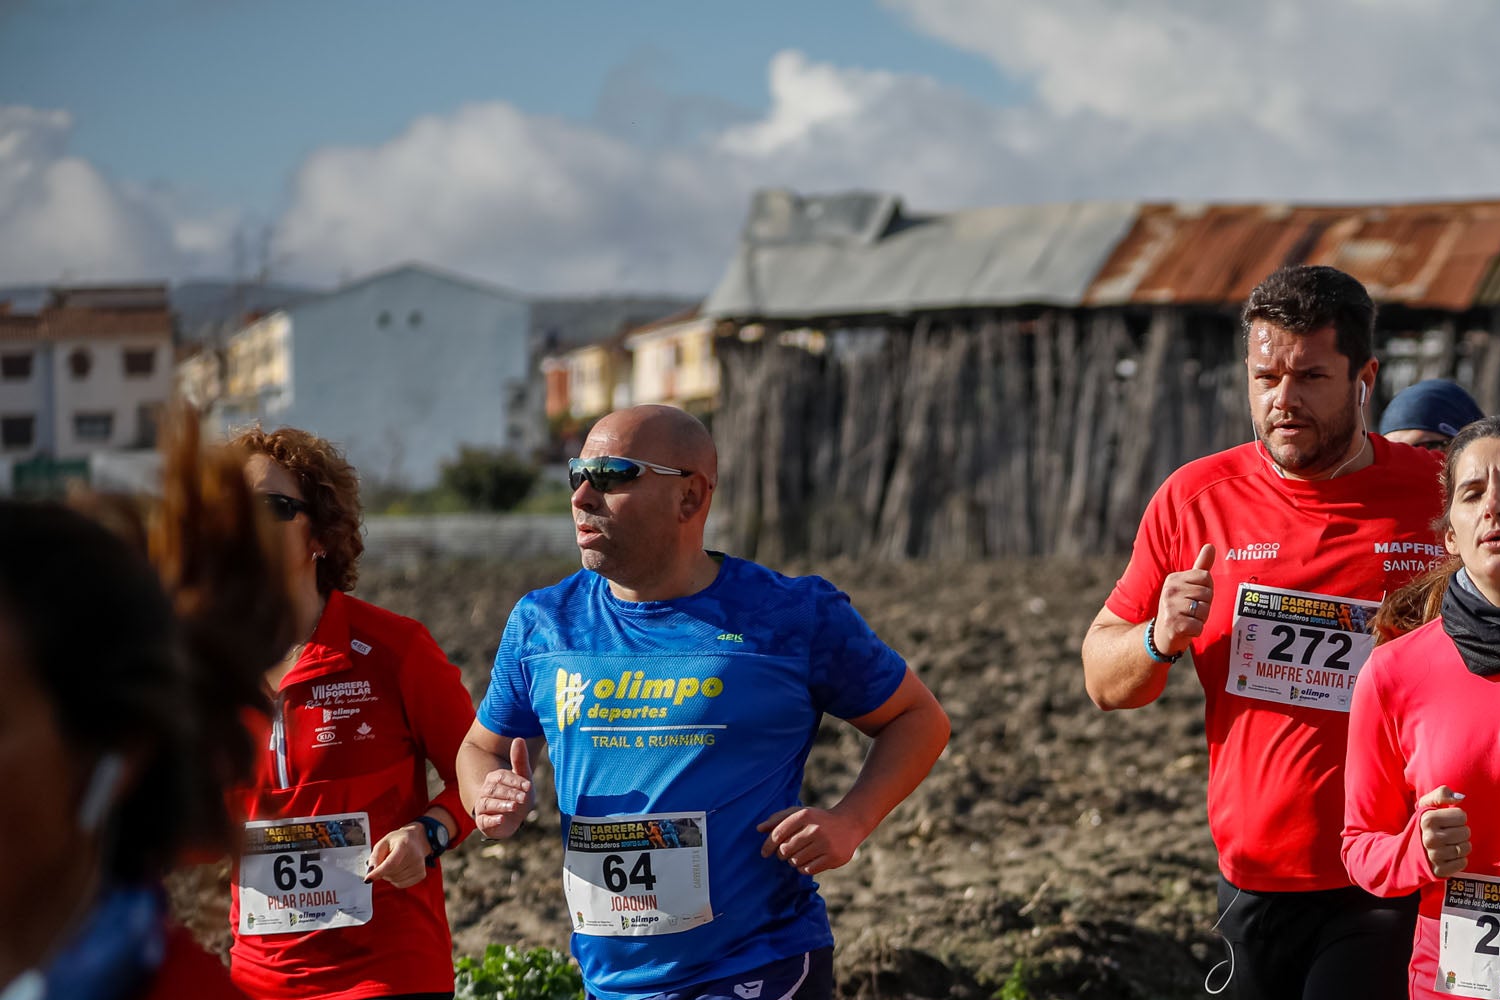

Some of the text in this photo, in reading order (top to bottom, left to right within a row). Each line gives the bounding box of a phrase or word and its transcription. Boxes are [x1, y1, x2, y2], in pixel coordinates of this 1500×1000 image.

[1225, 544, 1277, 560] Altium
[1374, 542, 1445, 557] MAPFRE
[1383, 560, 1426, 572] SANTA
[1245, 592, 1259, 603] 26
[1270, 594, 1282, 611] VII
[1281, 596, 1337, 612] CARRERA
[1243, 606, 1310, 622] Ruta de los Secaderos
[1281, 605, 1336, 619] POPULAR
[1267, 624, 1353, 671] 272
[1256, 661, 1358, 690] MAPFRE SANTA F
[312, 685, 325, 700] VII
[326, 680, 370, 691] CARRERA
[593, 670, 724, 706] olimpo
[325, 688, 371, 698] POPULAR
[1301, 688, 1330, 699] olimpo
[332, 708, 360, 717] olimpo
[587, 703, 668, 723] deportes
[319, 733, 333, 741] KIA
[591, 734, 715, 748] TRAIL & RUNNING
[590, 823, 645, 834] CARRERA
[591, 832, 645, 842] POPULAR
[590, 841, 620, 849] Secaderos
[273, 854, 323, 891] 65
[602, 852, 656, 893] 64
[1451, 880, 1464, 892] 26
[267, 890, 340, 911] PILAR PADIAL
[610, 895, 658, 912] JOAQUIN
[1449, 896, 1463, 904] Ruta
[1472, 899, 1481, 907] los
[298, 911, 326, 920] olimpo
[630, 915, 659, 924] olimpo
